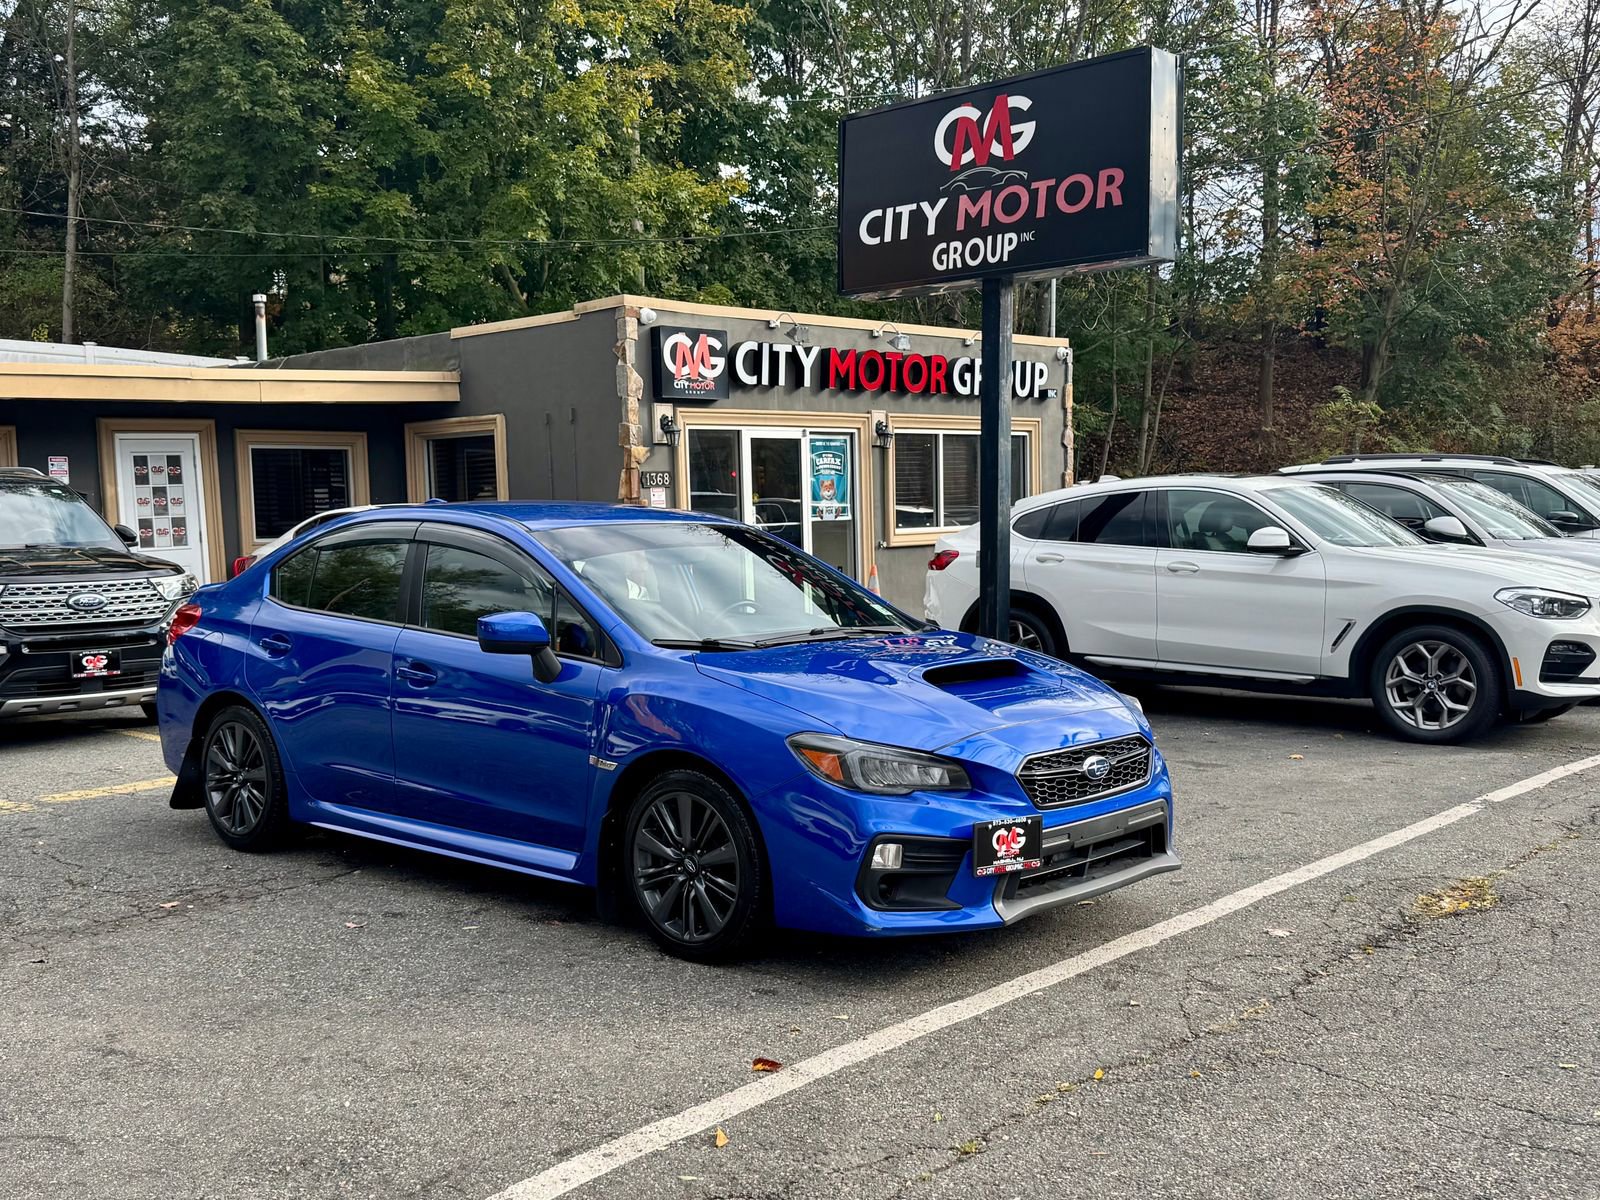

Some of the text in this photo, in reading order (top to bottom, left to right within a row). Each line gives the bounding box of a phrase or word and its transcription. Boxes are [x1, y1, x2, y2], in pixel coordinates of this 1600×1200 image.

[858, 167, 1125, 246] CITY MOTOR
[932, 230, 1036, 272] GROUP INC
[689, 381, 715, 390] MOTOR
[735, 341, 821, 387] CITY
[829, 347, 948, 394] MOTOR
[646, 472, 670, 486] 1368
